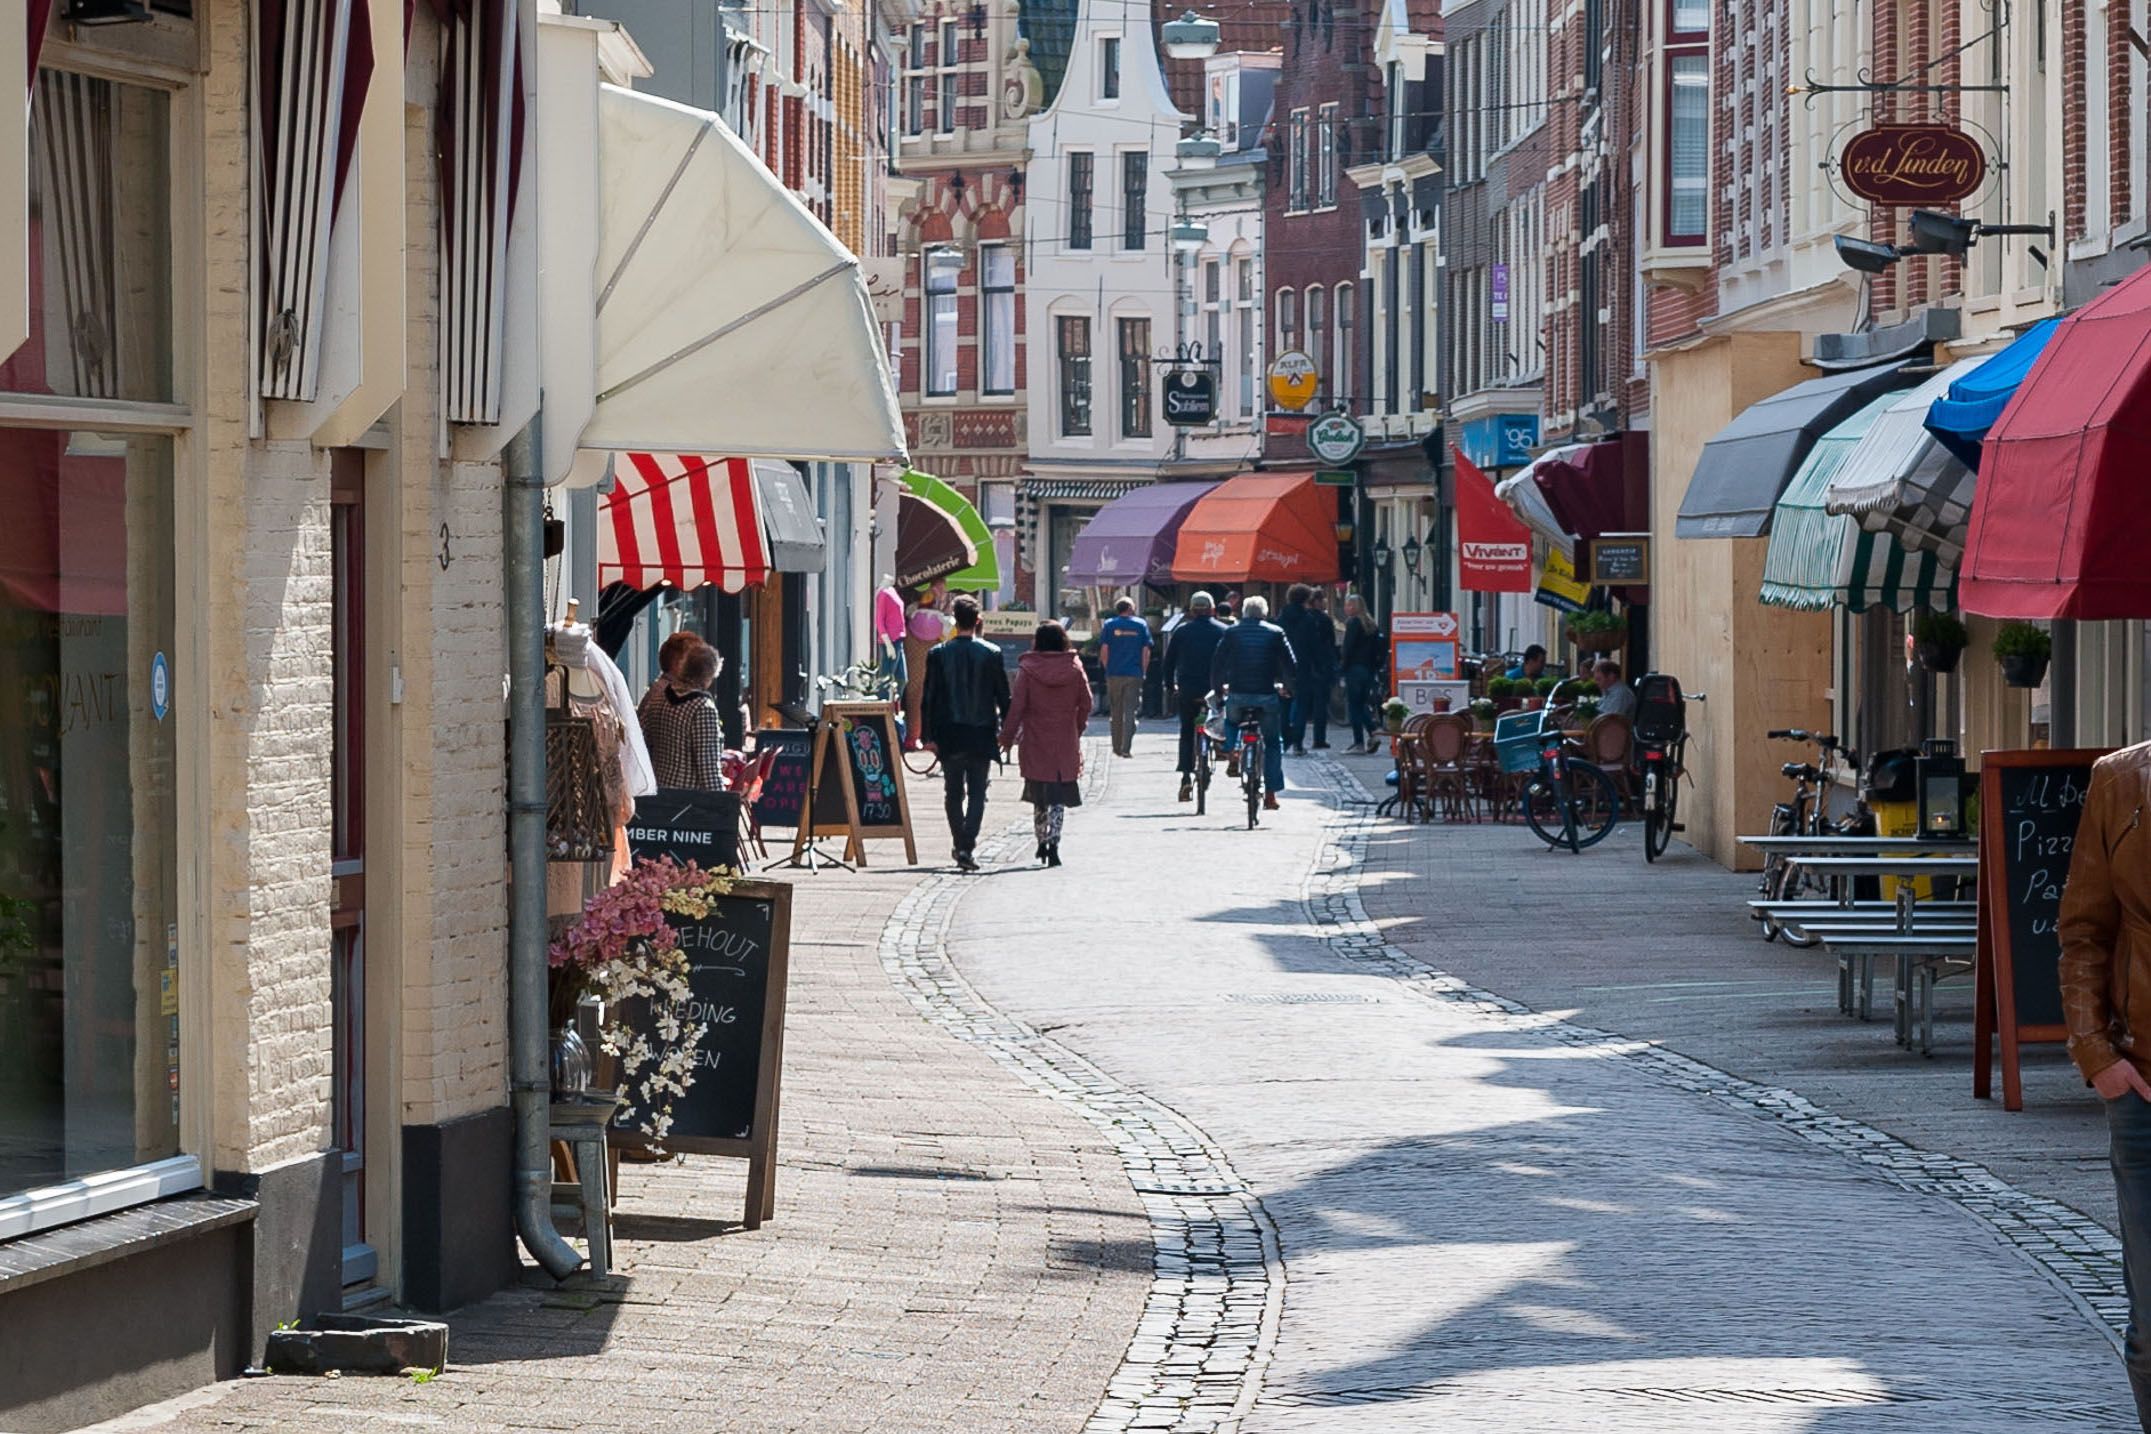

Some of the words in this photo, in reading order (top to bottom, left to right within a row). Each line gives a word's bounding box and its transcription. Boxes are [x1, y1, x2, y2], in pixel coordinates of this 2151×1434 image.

[1873, 131, 1969, 188] Linden
[438, 523, 450, 571] 3
[896, 556, 961, 588] Chocolaterie
[673, 831, 711, 844] NINE
